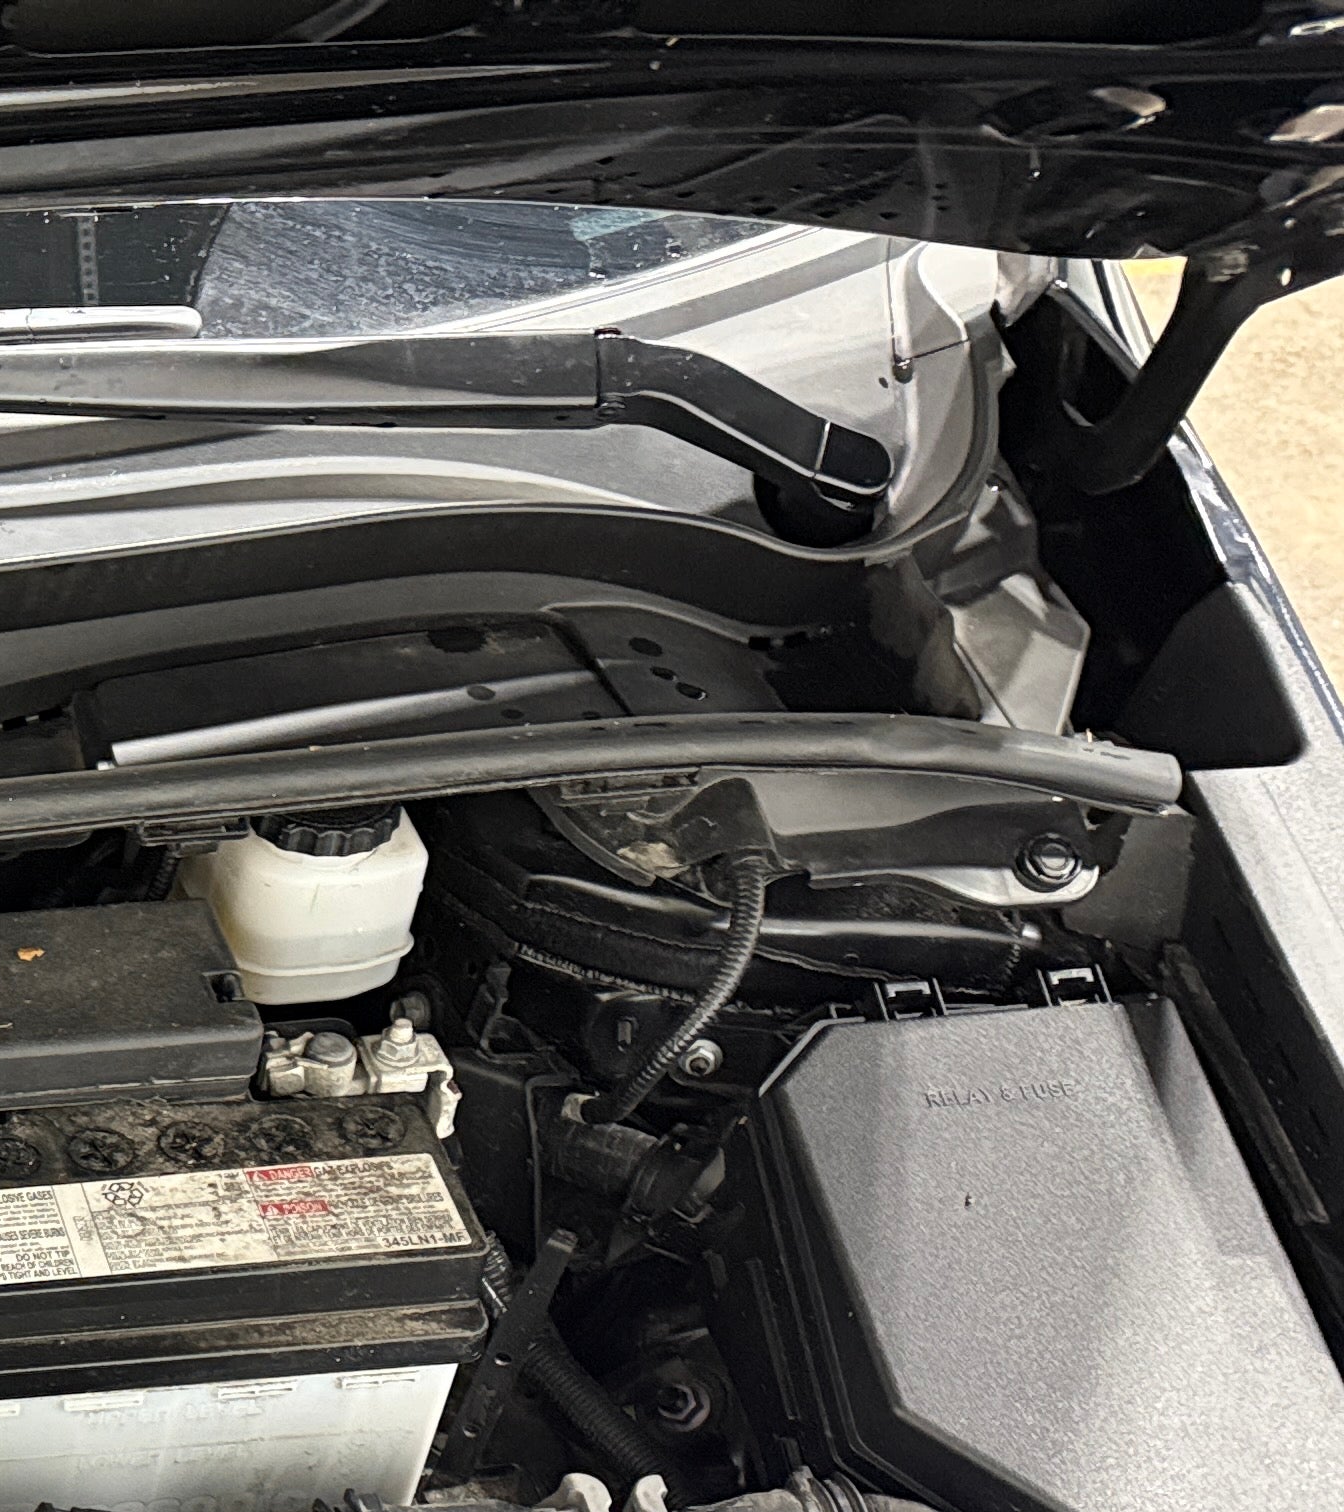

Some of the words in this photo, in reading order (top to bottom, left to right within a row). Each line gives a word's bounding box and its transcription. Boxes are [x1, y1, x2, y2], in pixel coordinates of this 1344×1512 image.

[923, 1087, 991, 1109] RELAY
[1019, 1081, 1075, 1102] FUSE
[269, 1167, 312, 1180] DANGER
[26, 1190, 53, 1201] GASES
[16, 1252, 30, 1262] DO
[32, 1250, 53, 1260] NOT
[57, 1249, 70, 1258] TIP
[8, 1270, 33, 1280] TIGHT
[34, 1268, 51, 1278] AND
[53, 1266, 78, 1276] LEVEL
